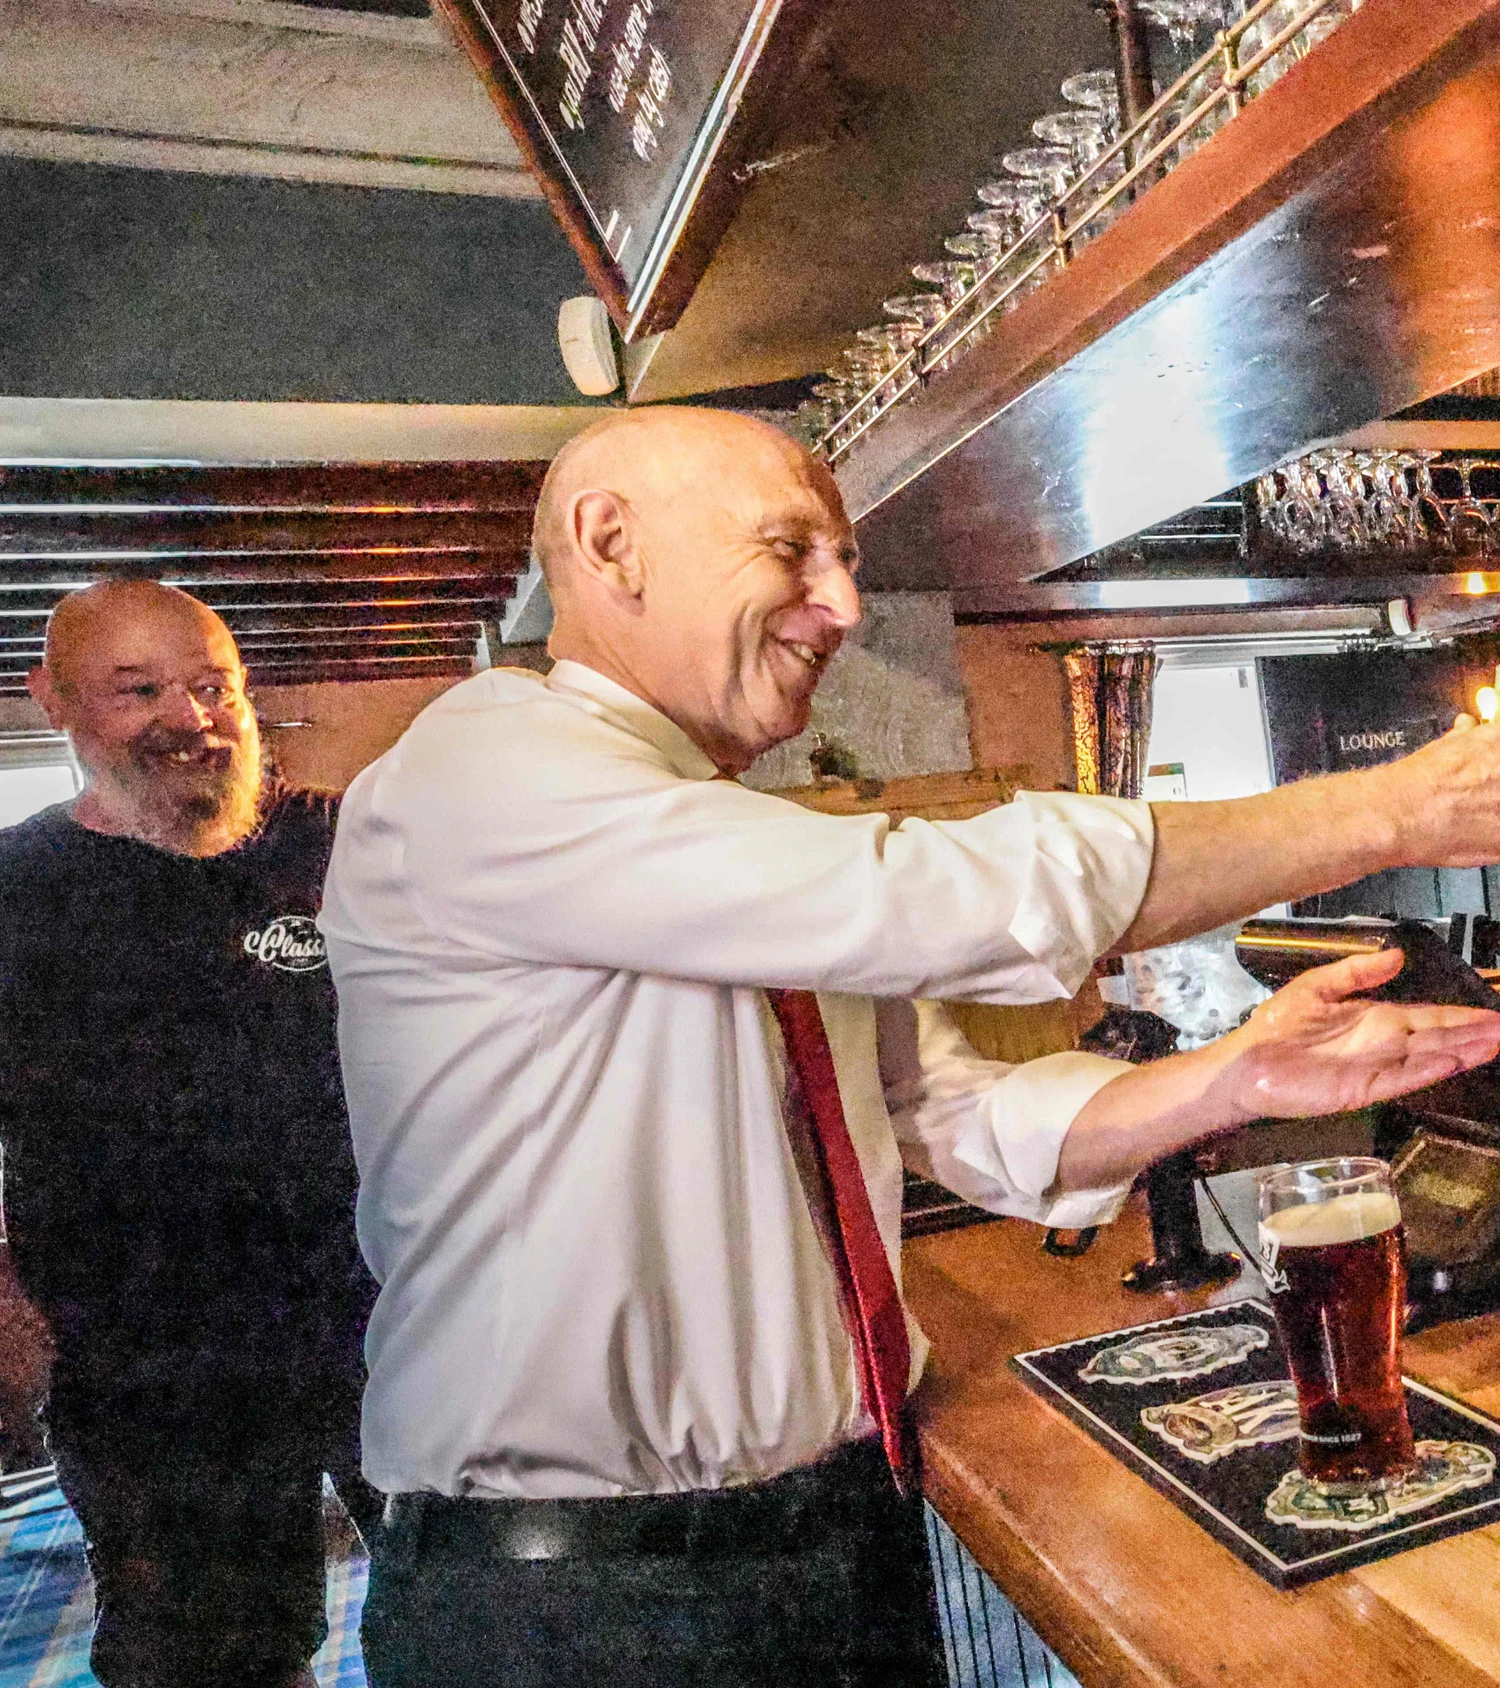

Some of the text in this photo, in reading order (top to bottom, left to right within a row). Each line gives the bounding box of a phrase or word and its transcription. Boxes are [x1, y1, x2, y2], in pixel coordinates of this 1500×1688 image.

[560, 18, 591, 92] PAY
[611, 43, 635, 82] the
[649, 43, 672, 102] cash
[635, 88, 665, 128] by
[1340, 731, 1407, 751] LOUNGE
